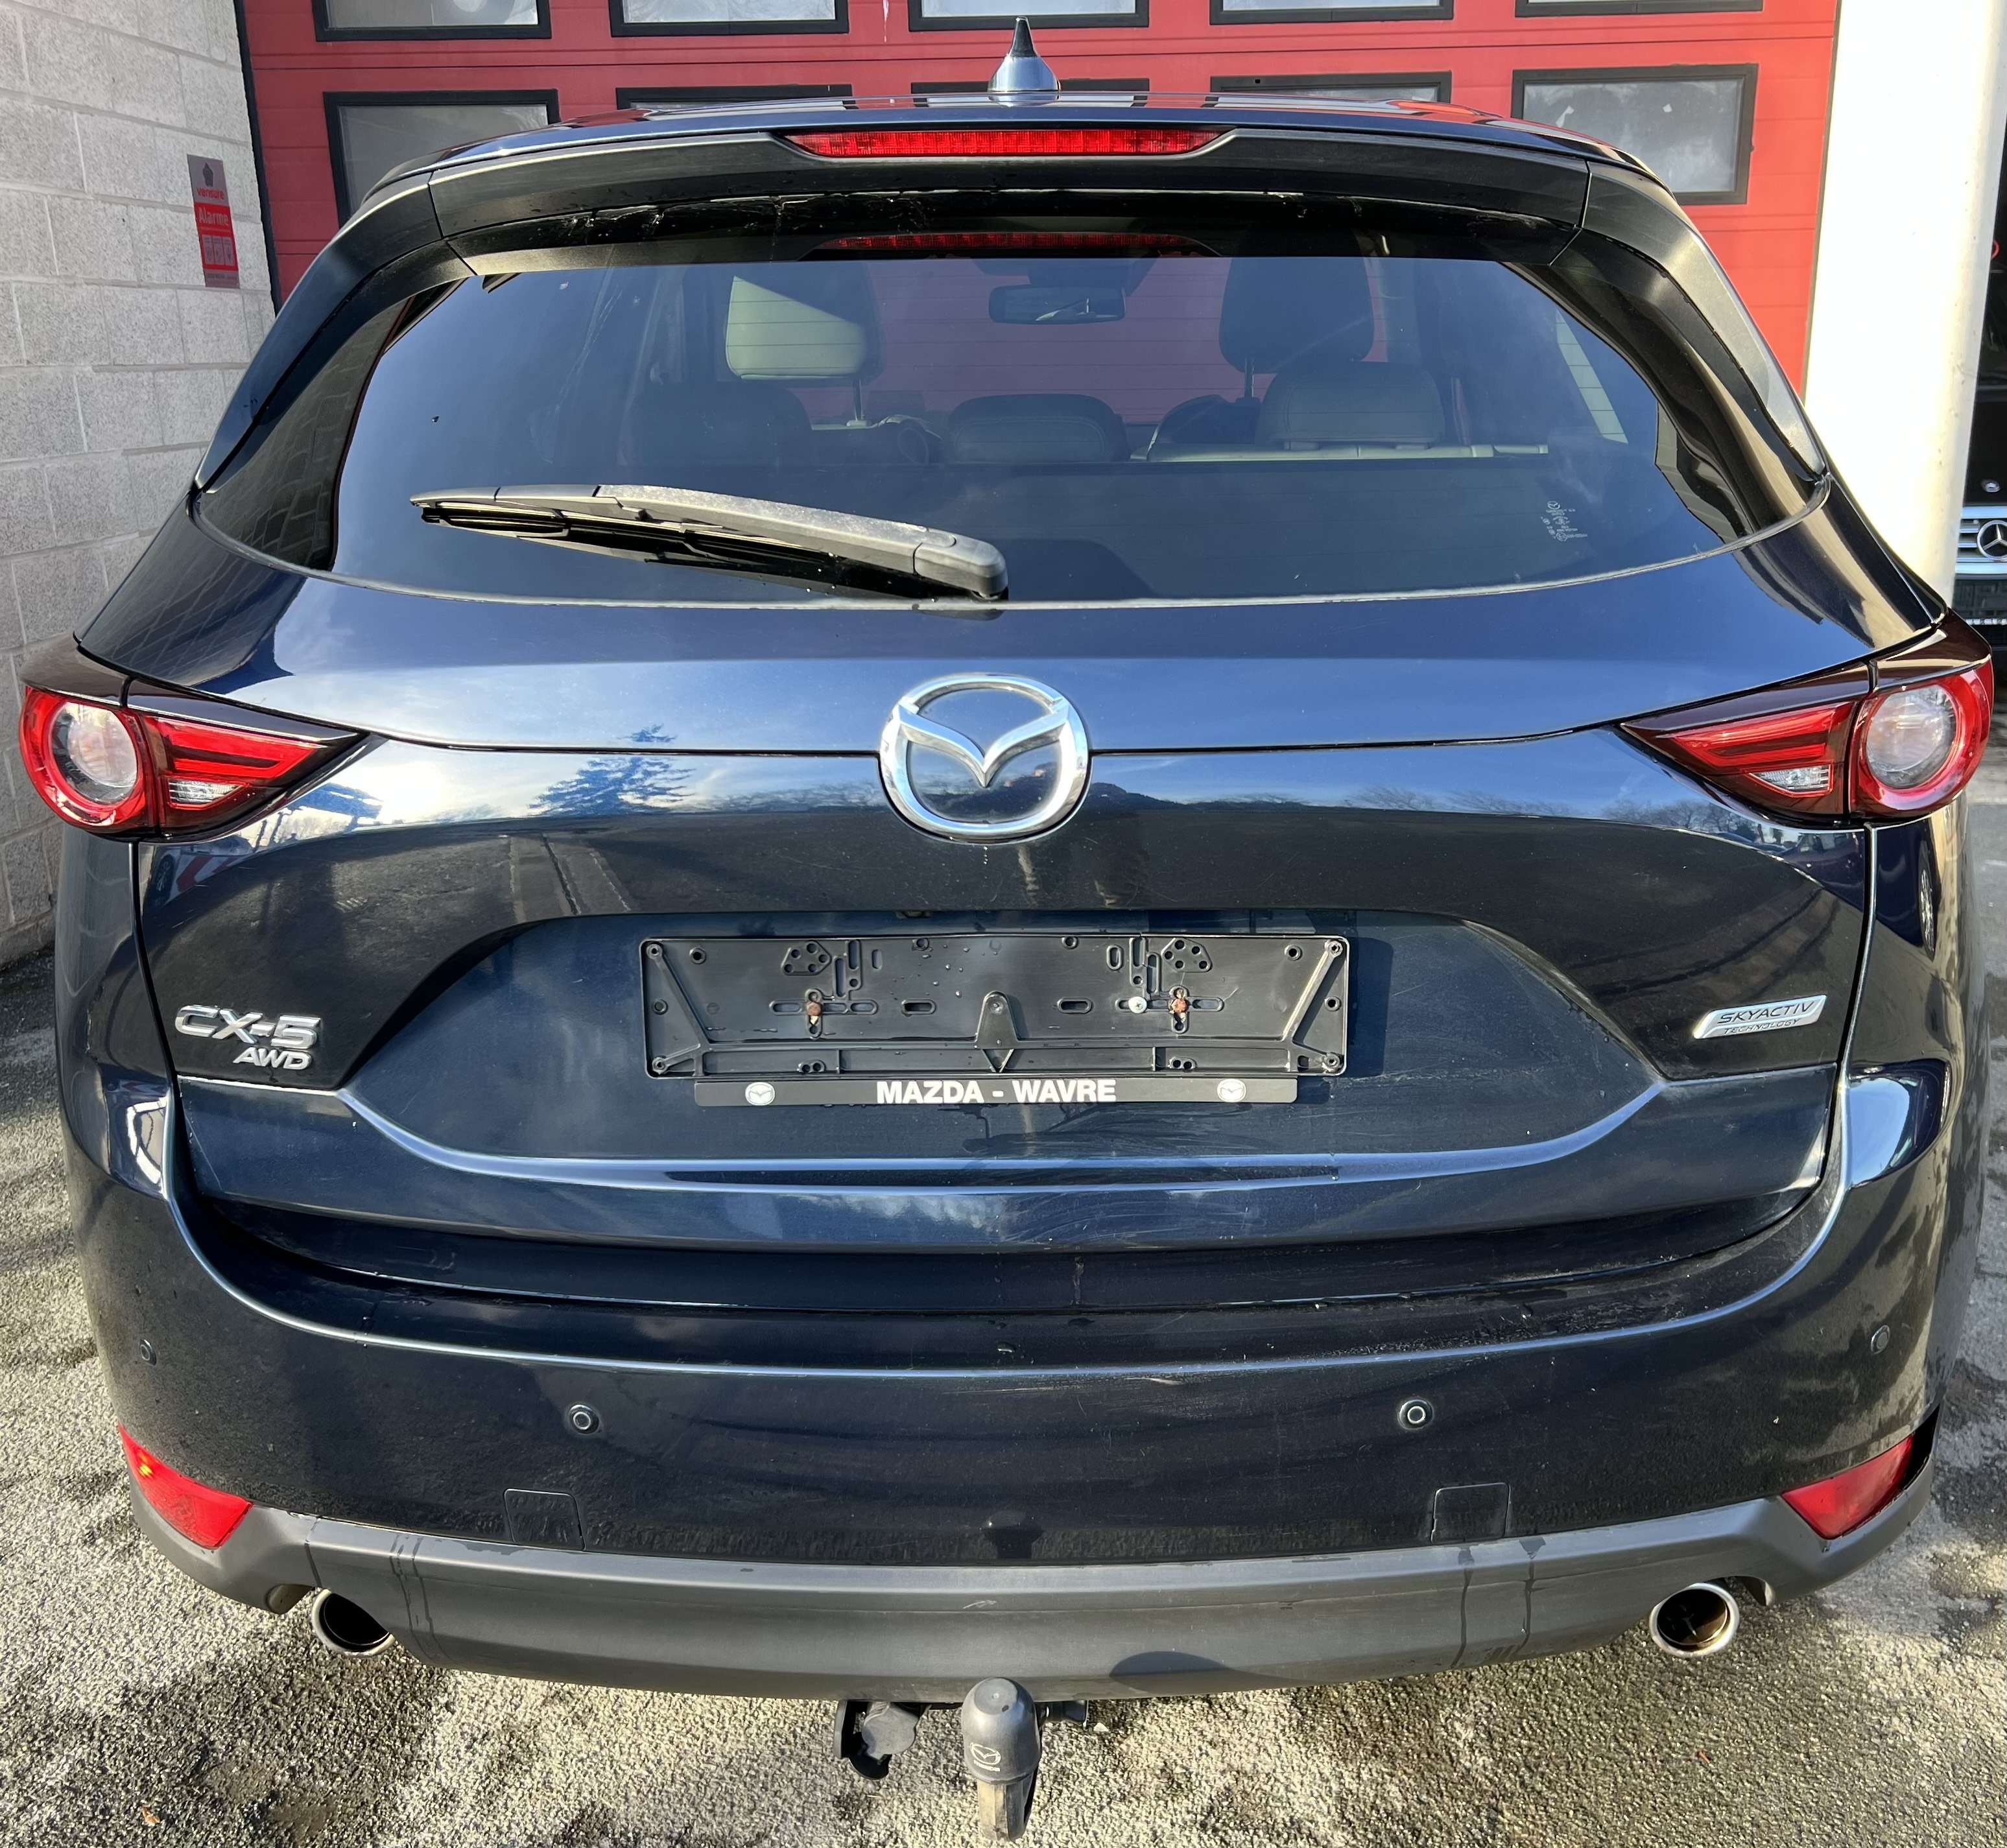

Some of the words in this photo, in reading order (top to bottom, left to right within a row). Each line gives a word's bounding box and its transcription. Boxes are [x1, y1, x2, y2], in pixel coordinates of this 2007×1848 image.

[198, 207, 229, 226] Alarme
[1716, 1001, 1814, 1024] SKYACTIV
[174, 1004, 321, 1050] CX-5
[1724, 1018, 1801, 1035] TECHNOLOGY
[233, 1047, 312, 1070] AWD
[876, 1080, 984, 1104] MAZDA
[1011, 1079, 1116, 1103] WAVRE
